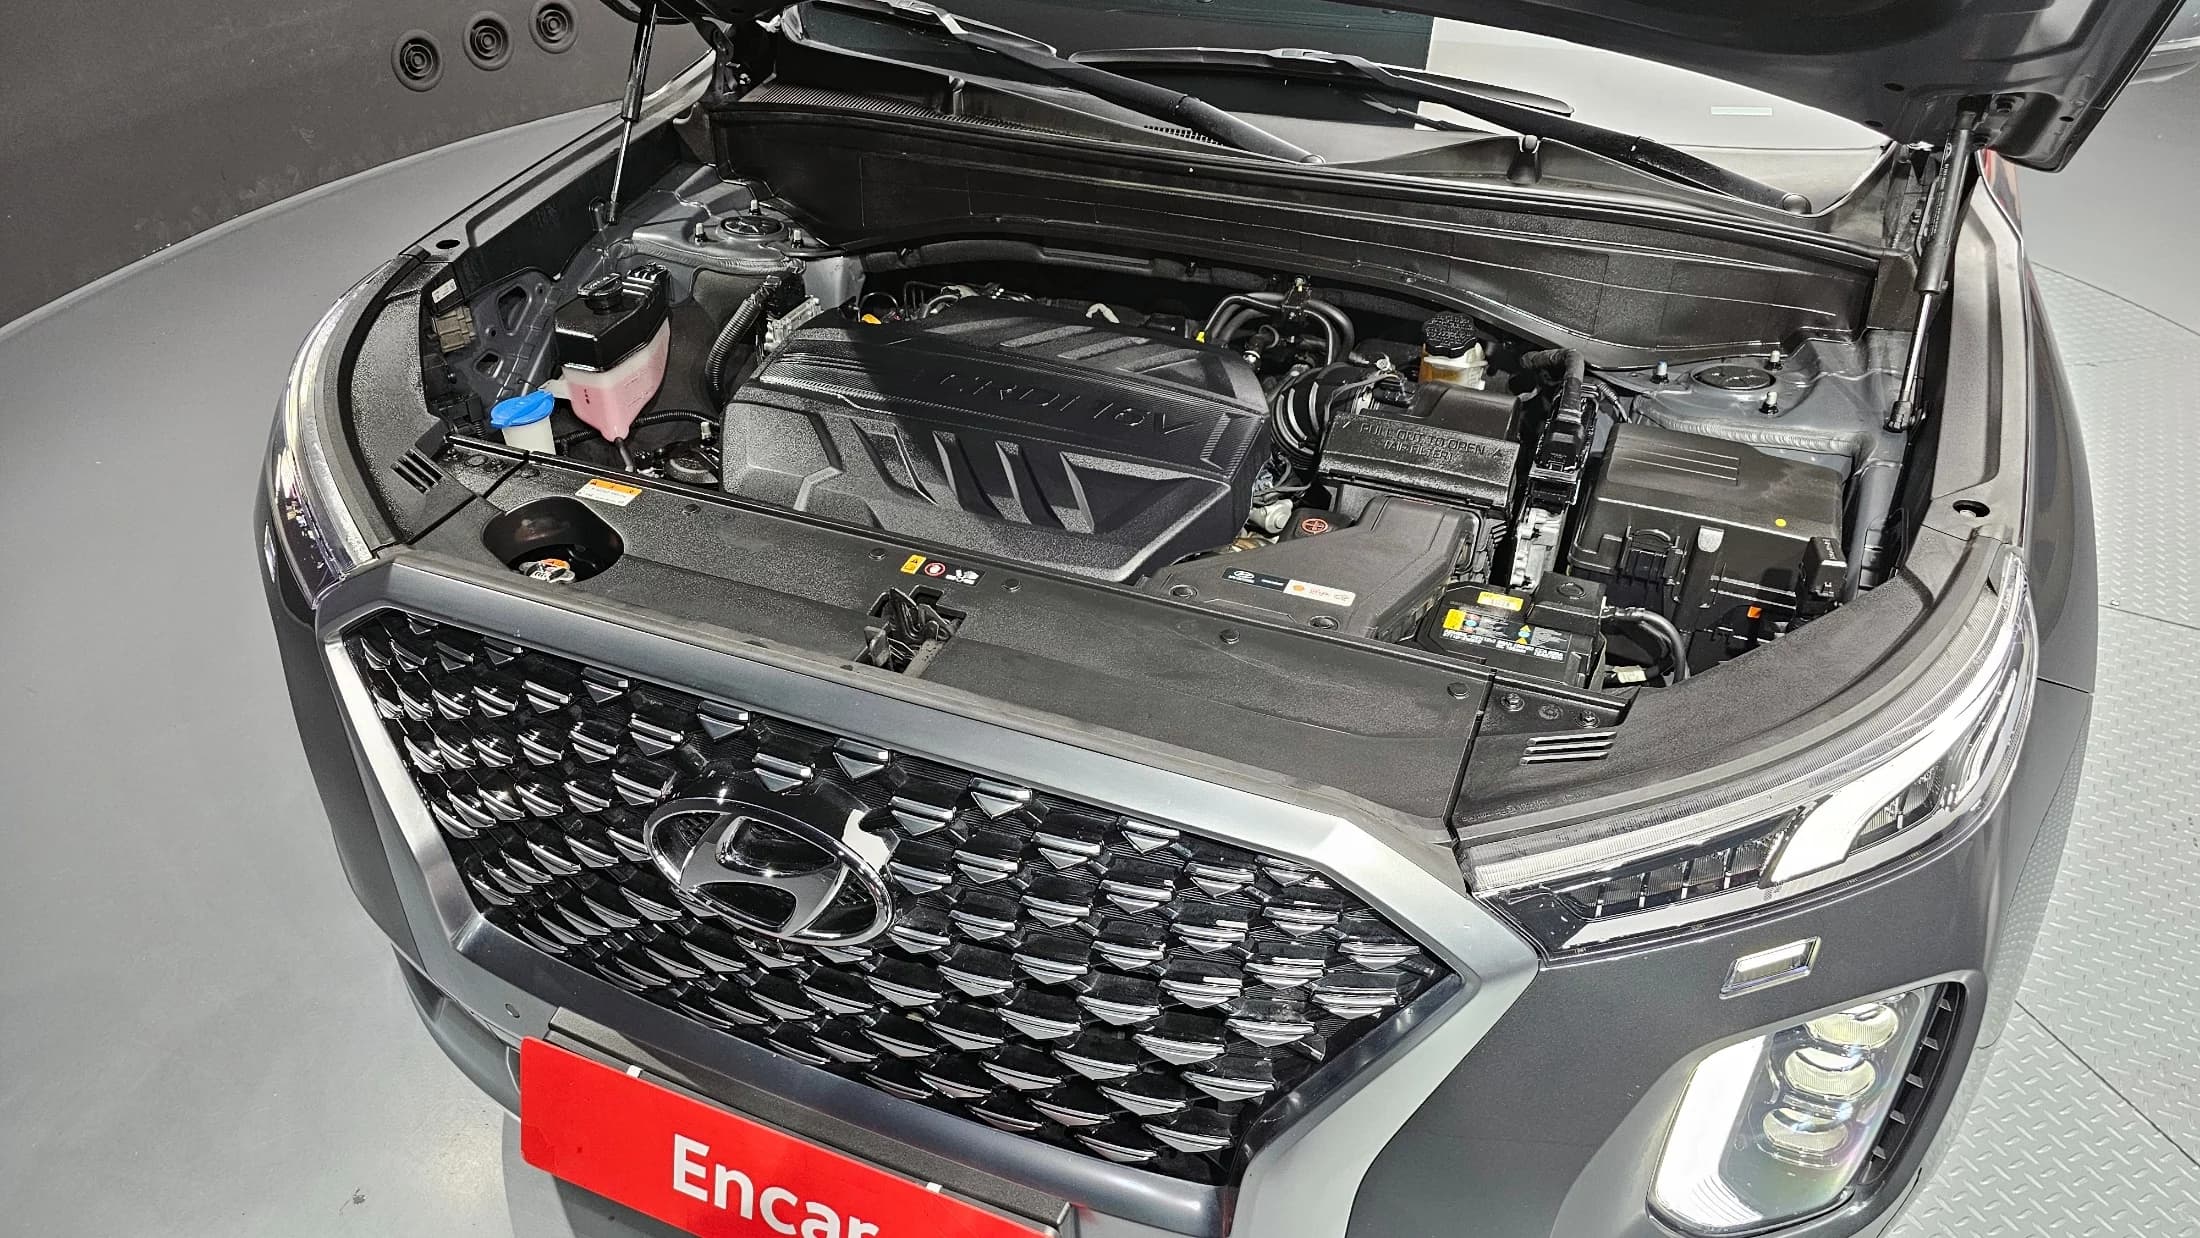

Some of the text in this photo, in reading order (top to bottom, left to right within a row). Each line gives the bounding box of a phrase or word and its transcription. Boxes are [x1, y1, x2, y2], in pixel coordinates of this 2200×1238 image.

[1360, 423, 1486, 456] PULL OUT TO OPEN
[673, 1133, 880, 1238] Encar
